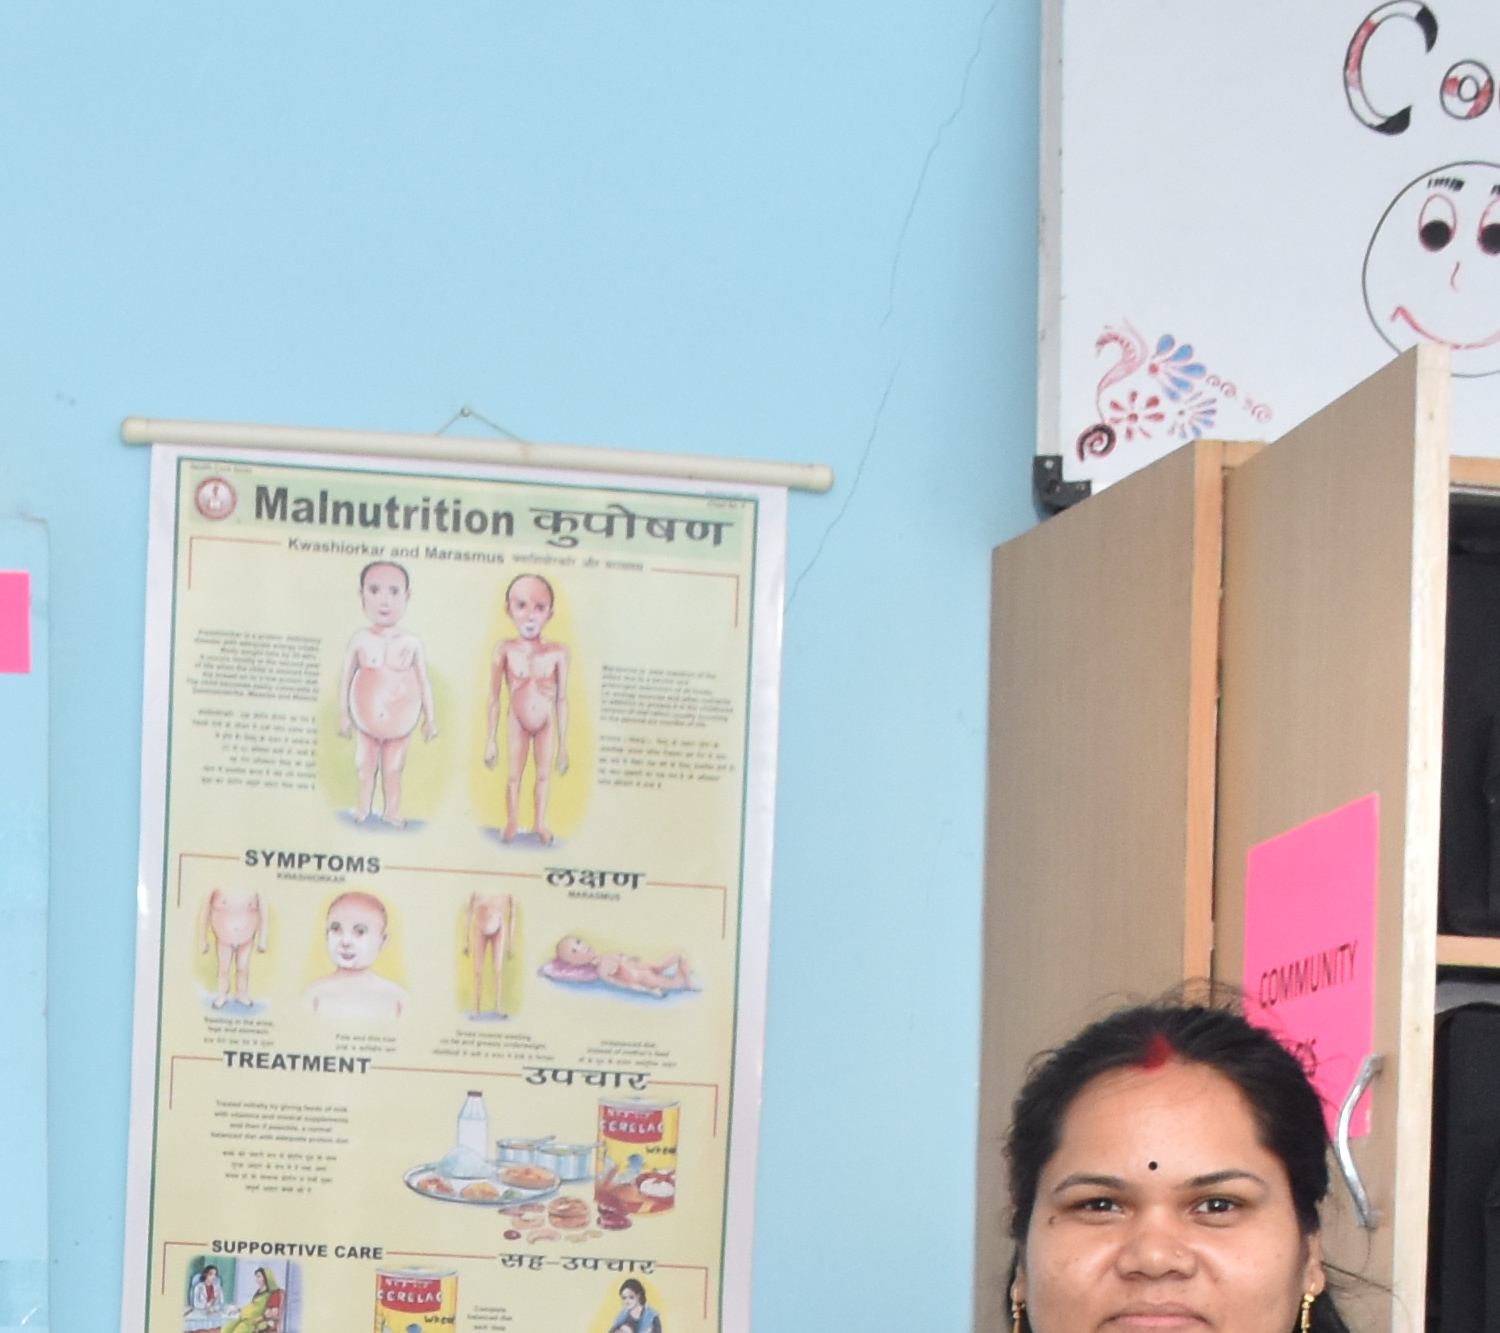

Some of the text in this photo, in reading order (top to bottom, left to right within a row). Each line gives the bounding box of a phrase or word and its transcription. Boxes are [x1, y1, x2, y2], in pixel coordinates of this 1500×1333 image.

[254, 484, 515, 538] Malnutrition
[529, 501, 734, 549] कुपोषण
[287, 538, 386, 558] Kwashiorkar
[390, 546, 420, 559] and
[424, 547, 505, 564] Marasmus
[244, 849, 381, 875] SYMPTOMS
[544, 866, 647, 890] लक्षण
[1259, 940, 1358, 1009] COMMUNITY
[223, 1049, 372, 1075] TREATMENT
[522, 1066, 651, 1091] उपचार
[211, 1239, 384, 1260] SUPPORTIVE CARE
[498, 1251, 658, 1276] सह-उपचार
